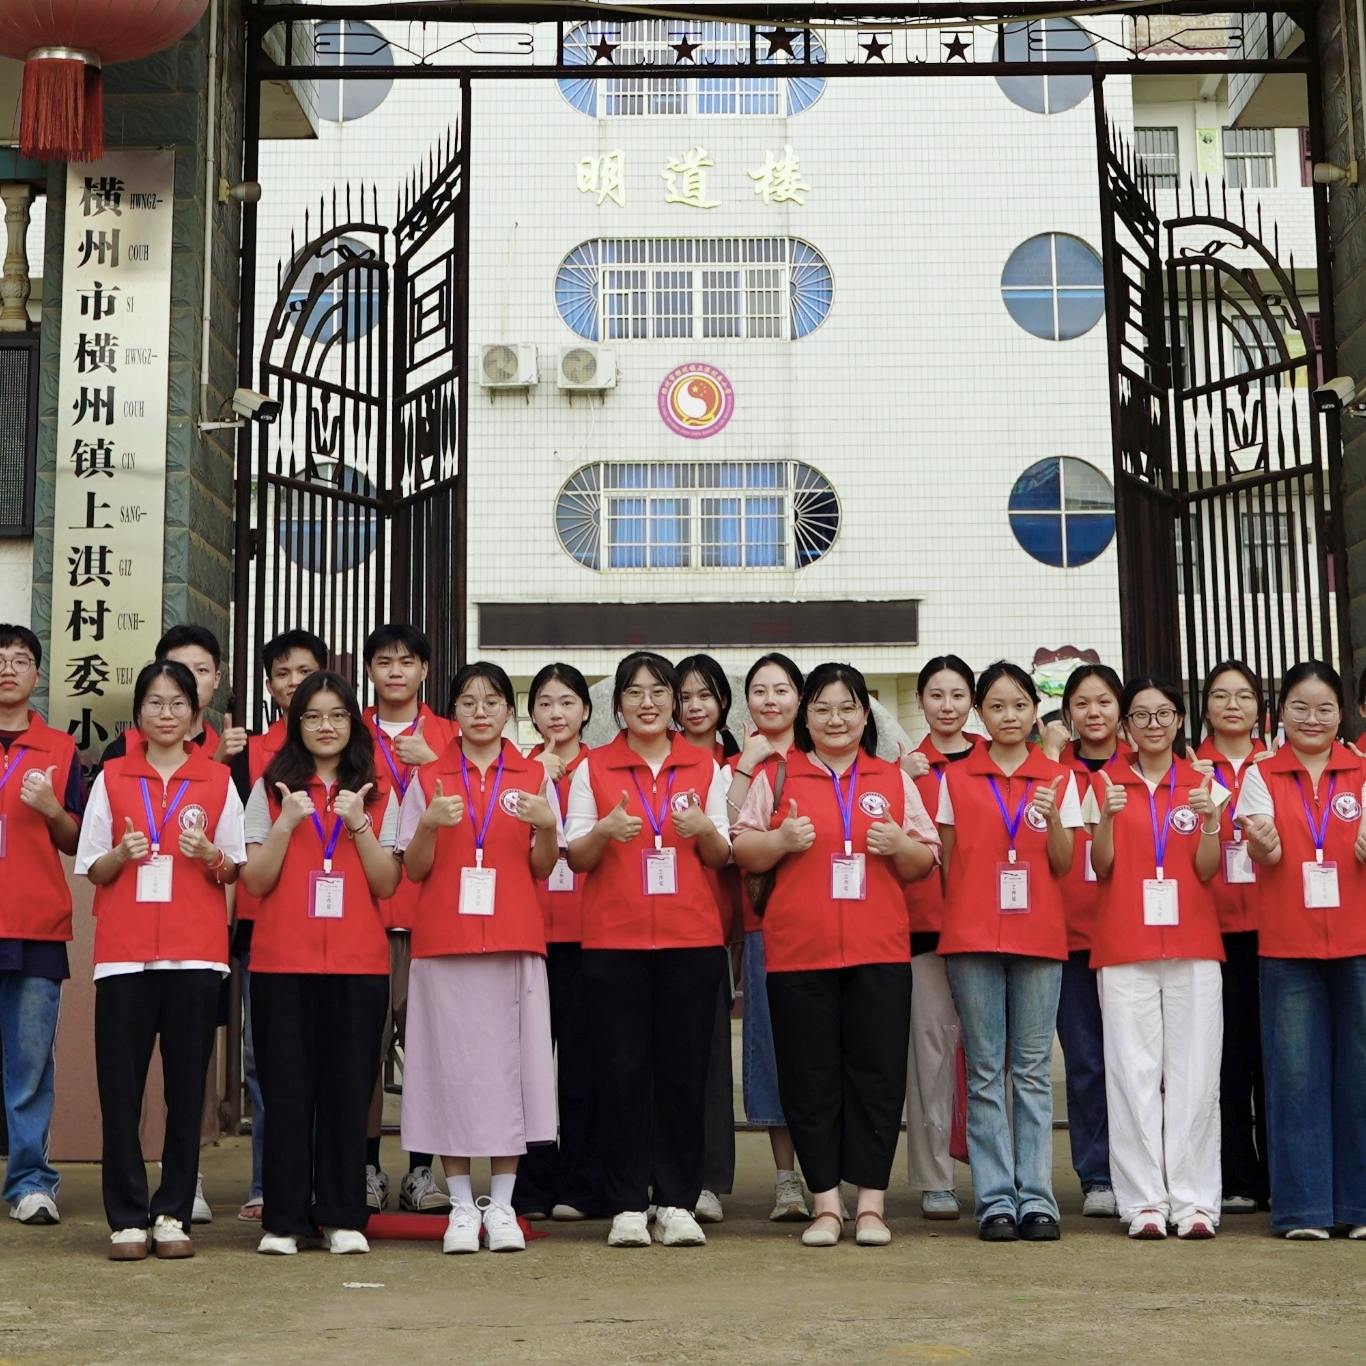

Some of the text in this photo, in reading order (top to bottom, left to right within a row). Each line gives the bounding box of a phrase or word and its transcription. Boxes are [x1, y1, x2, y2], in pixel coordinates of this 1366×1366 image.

[575, 145, 812, 209] 明道楼
[128, 244, 149, 261] COUH
[126, 296, 134, 313] SI
[123, 400, 145, 417] COUH
[121, 452, 135, 470] CIN
[63, 176, 126, 774] 横州市横州镇上淇村委小
[119, 559, 132, 577] GIZ
[116, 667, 134, 685] VEIJ
